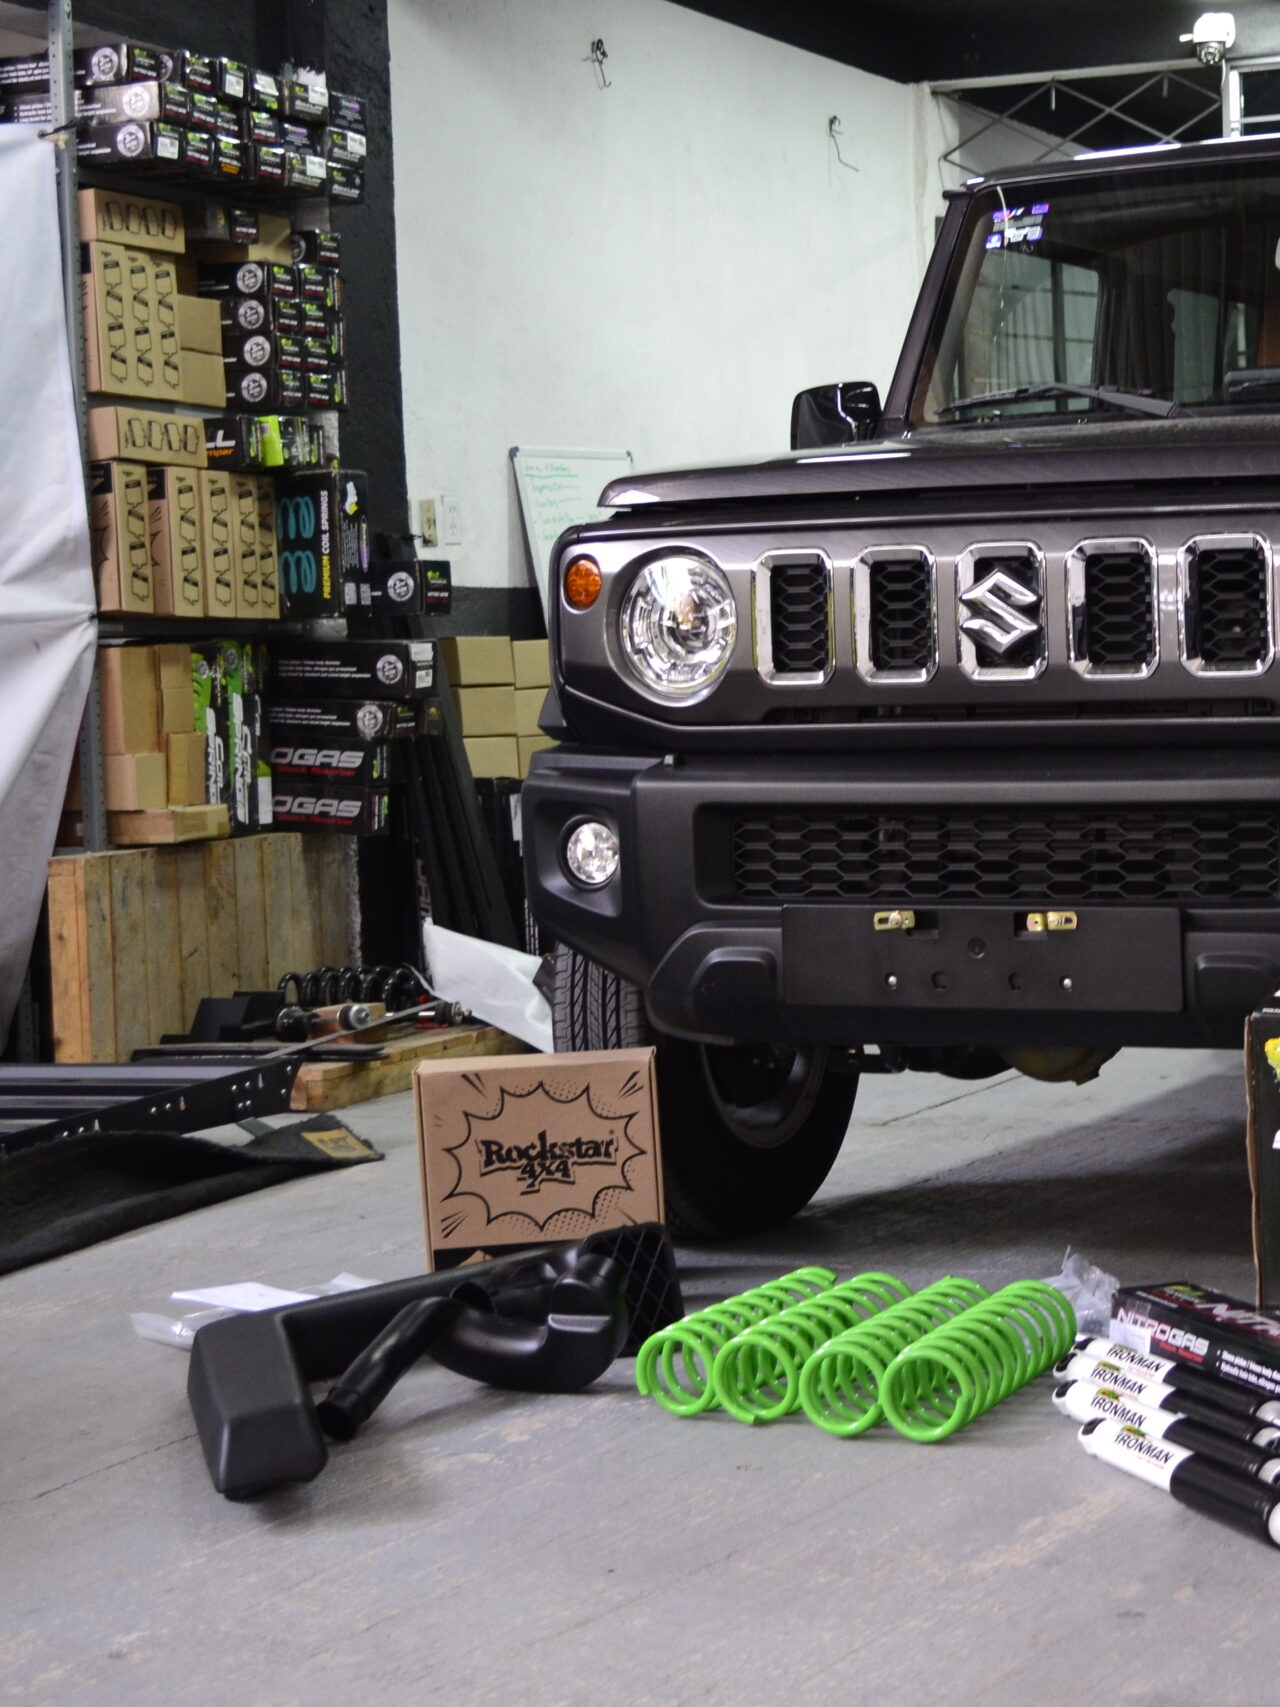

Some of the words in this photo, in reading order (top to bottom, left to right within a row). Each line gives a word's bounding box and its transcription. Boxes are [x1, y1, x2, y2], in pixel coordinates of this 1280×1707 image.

[320, 490, 329, 529] SPRINGS
[321, 530, 330, 554] COIL
[323, 555, 332, 599] PREMIUM
[480, 1130, 614, 1166] Rockstar
[1117, 1306, 1210, 1356] NITROGAS
[1106, 1346, 1166, 1373] IRONMAN
[1090, 1366, 1148, 1395] IRONMAN
[1090, 1395, 1148, 1428] IRONMAN
[1114, 1433, 1175, 1464] IRONMAN
